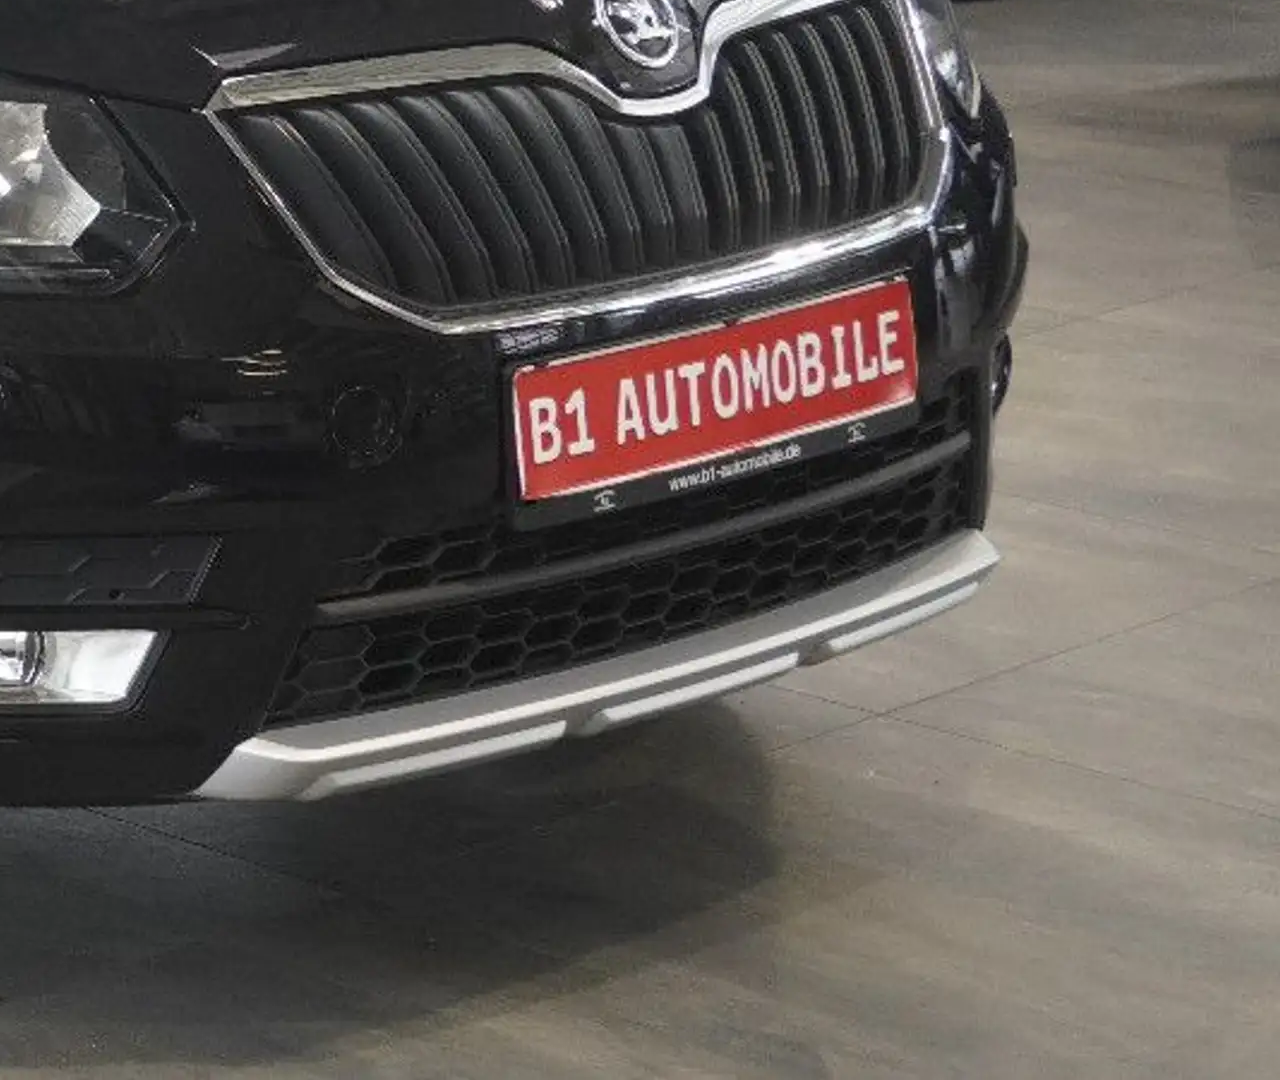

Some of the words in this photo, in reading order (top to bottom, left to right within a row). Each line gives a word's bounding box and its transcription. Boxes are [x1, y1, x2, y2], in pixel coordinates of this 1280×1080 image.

[529, 387, 596, 464] B1
[615, 309, 905, 446] AUTOMOBILE
[668, 442, 802, 492] www.b1-automobile.de
